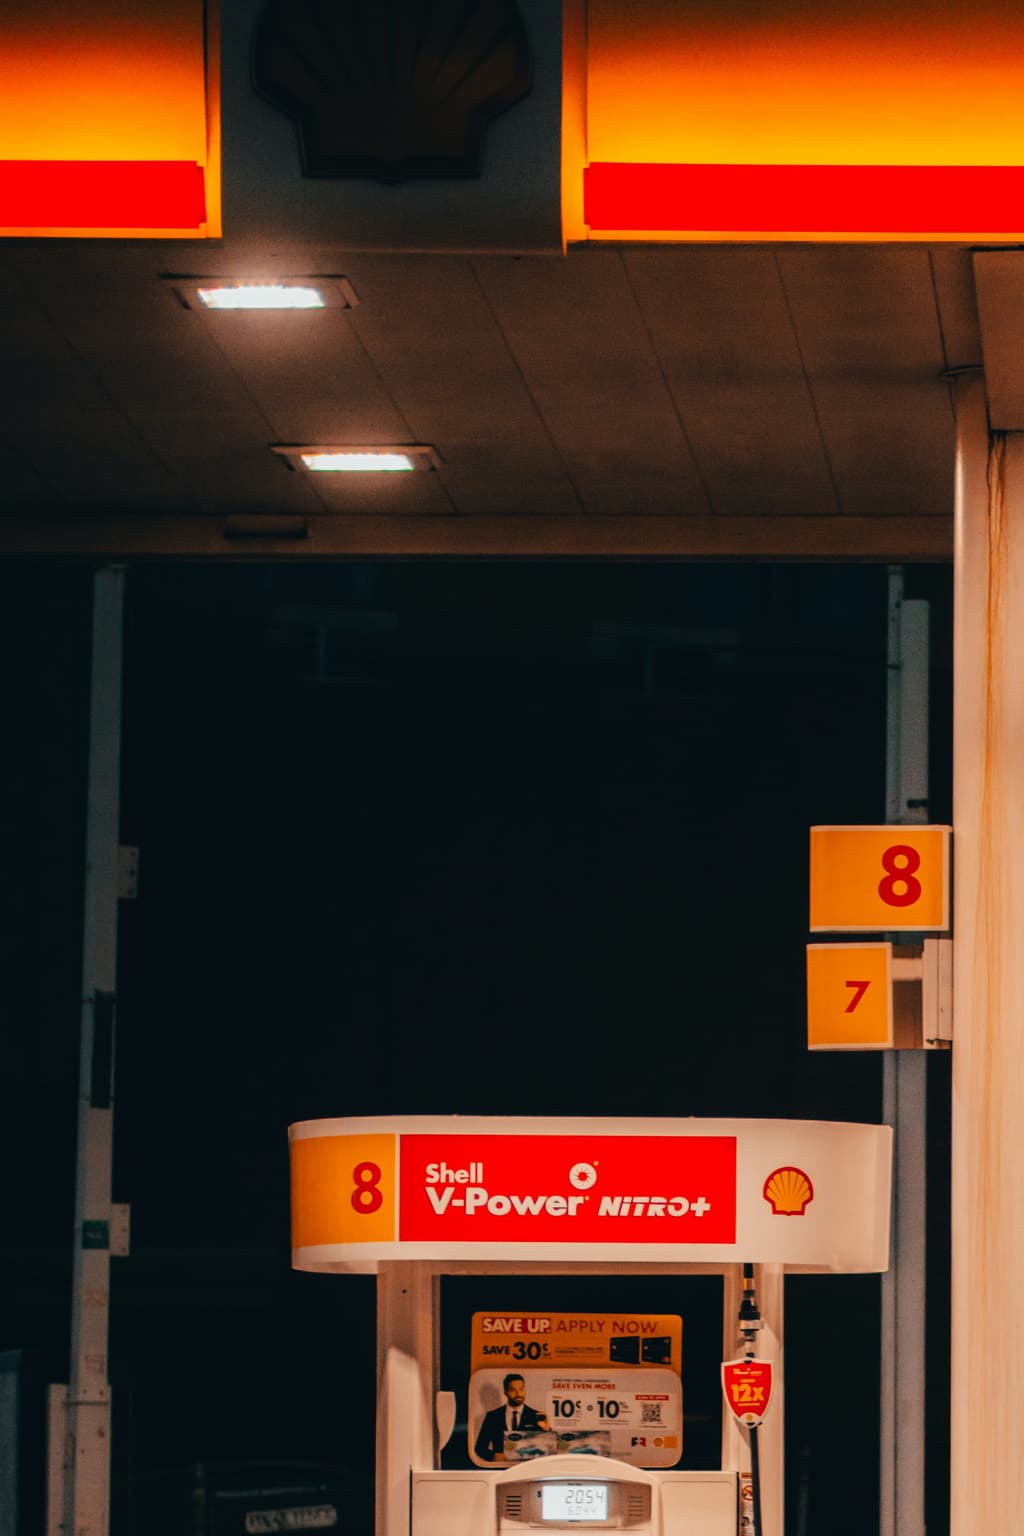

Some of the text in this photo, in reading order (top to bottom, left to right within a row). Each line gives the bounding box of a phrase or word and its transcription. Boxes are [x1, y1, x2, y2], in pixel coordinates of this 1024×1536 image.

[878, 845, 922, 908] 8
[844, 981, 871, 1013] 7
[351, 1161, 384, 1214] 8
[425, 1162, 484, 1184] Shell
[425, 1186, 584, 1217] V-Power
[482, 1318, 523, 1333] SAVE
[556, 1319, 606, 1333] APPLY
[612, 1320, 658, 1334] NOW
[482, 1345, 510, 1356] SAVE
